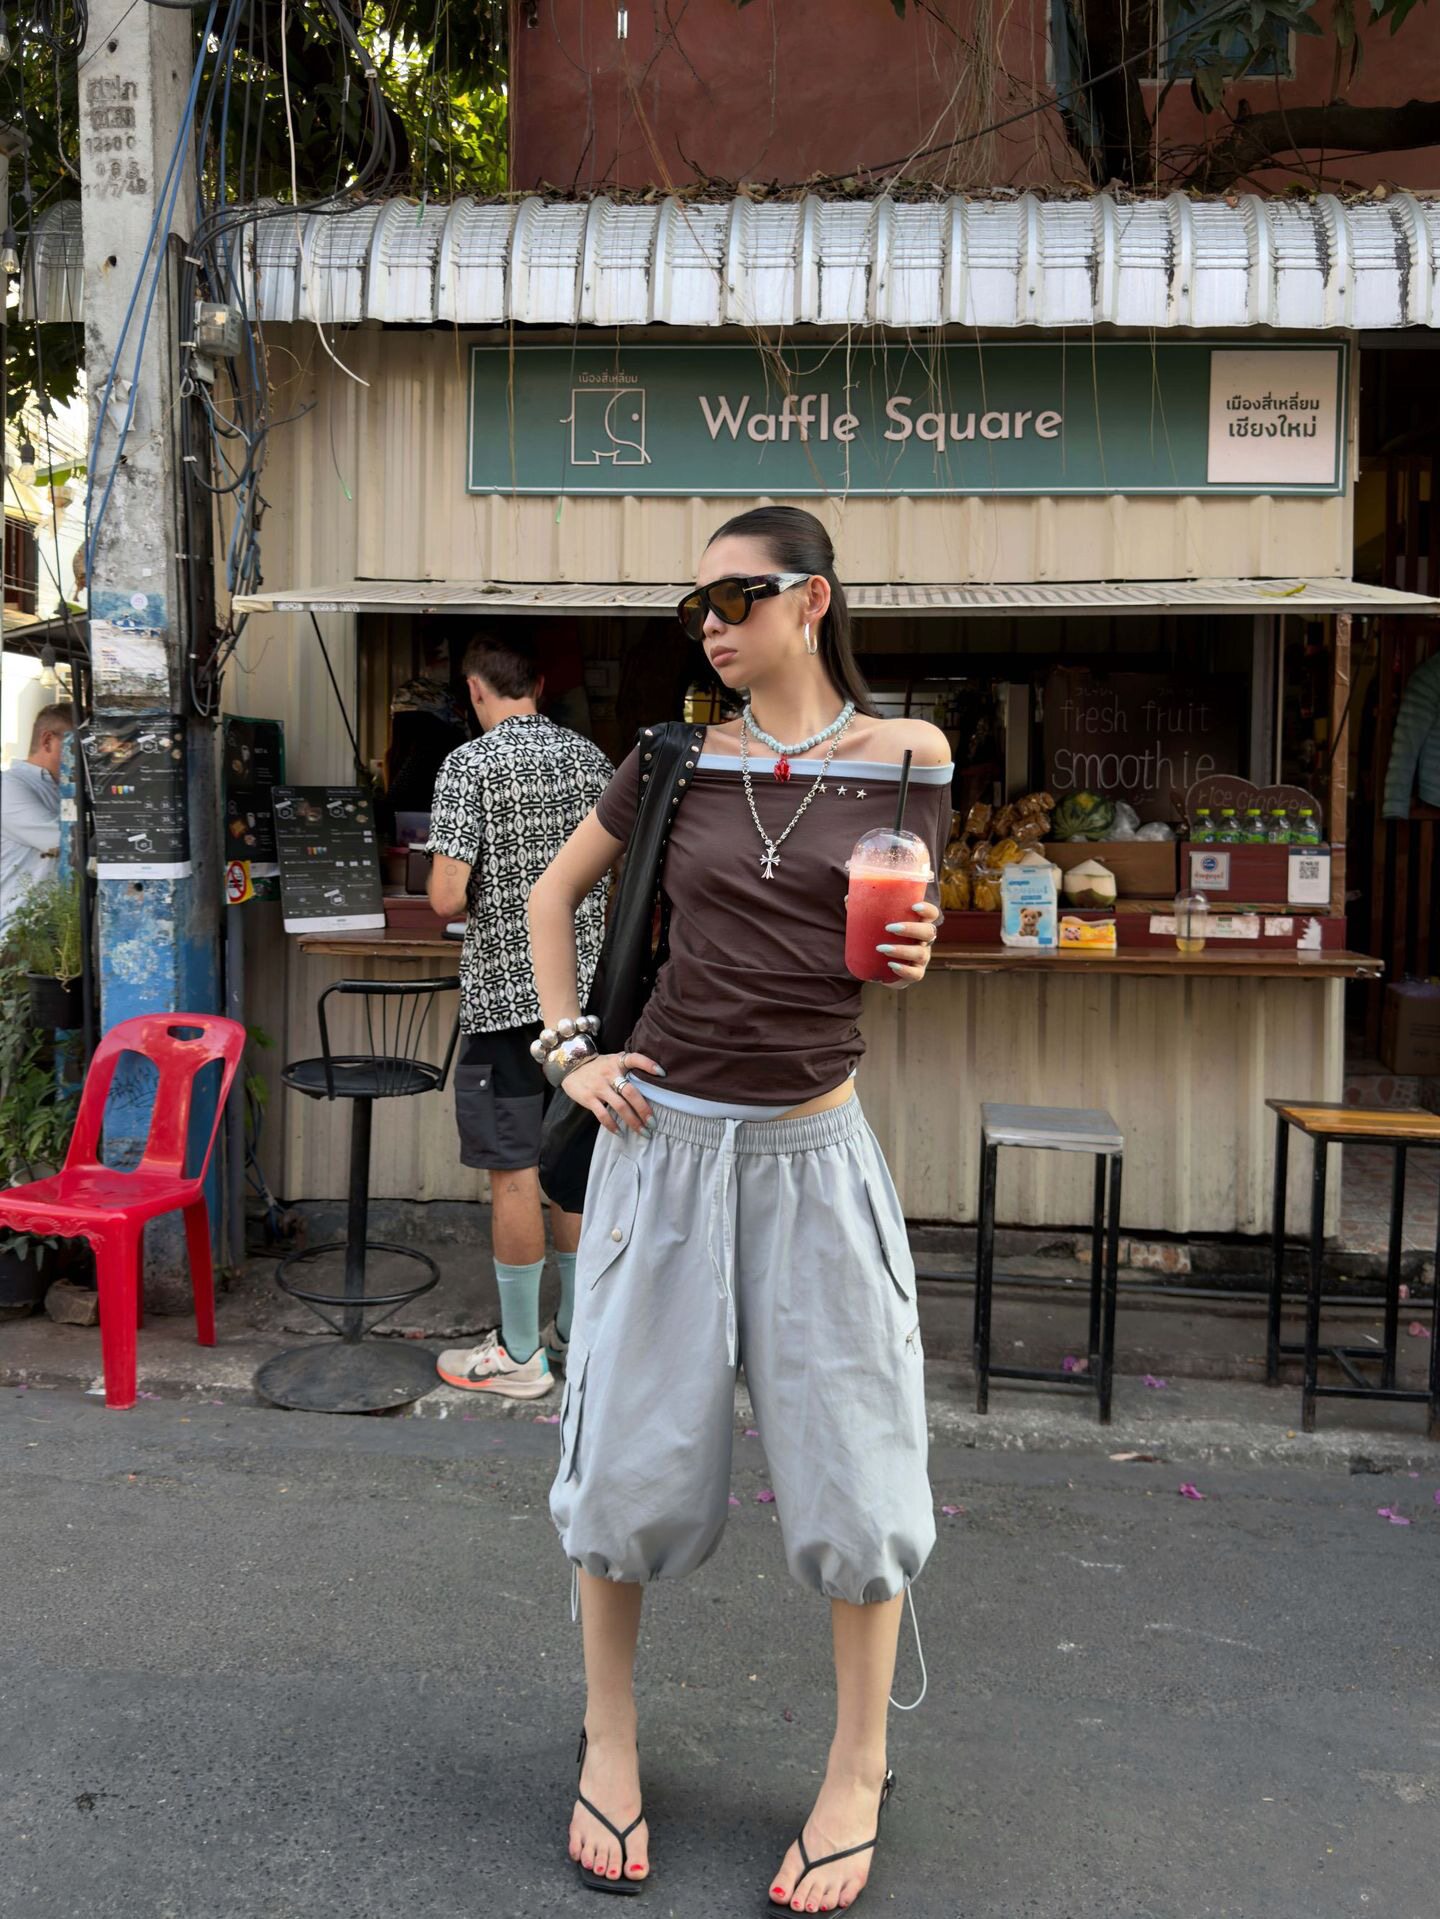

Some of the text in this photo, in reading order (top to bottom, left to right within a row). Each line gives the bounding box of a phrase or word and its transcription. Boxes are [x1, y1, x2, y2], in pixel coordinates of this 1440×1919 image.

[1226, 392, 1320, 410] เมืองสี่เหลี่ยม
[698, 393, 1063, 452] Waffle Square
[1228, 414, 1317, 437] เชียงใหม่
[1059, 693, 1211, 733] fresh fruit
